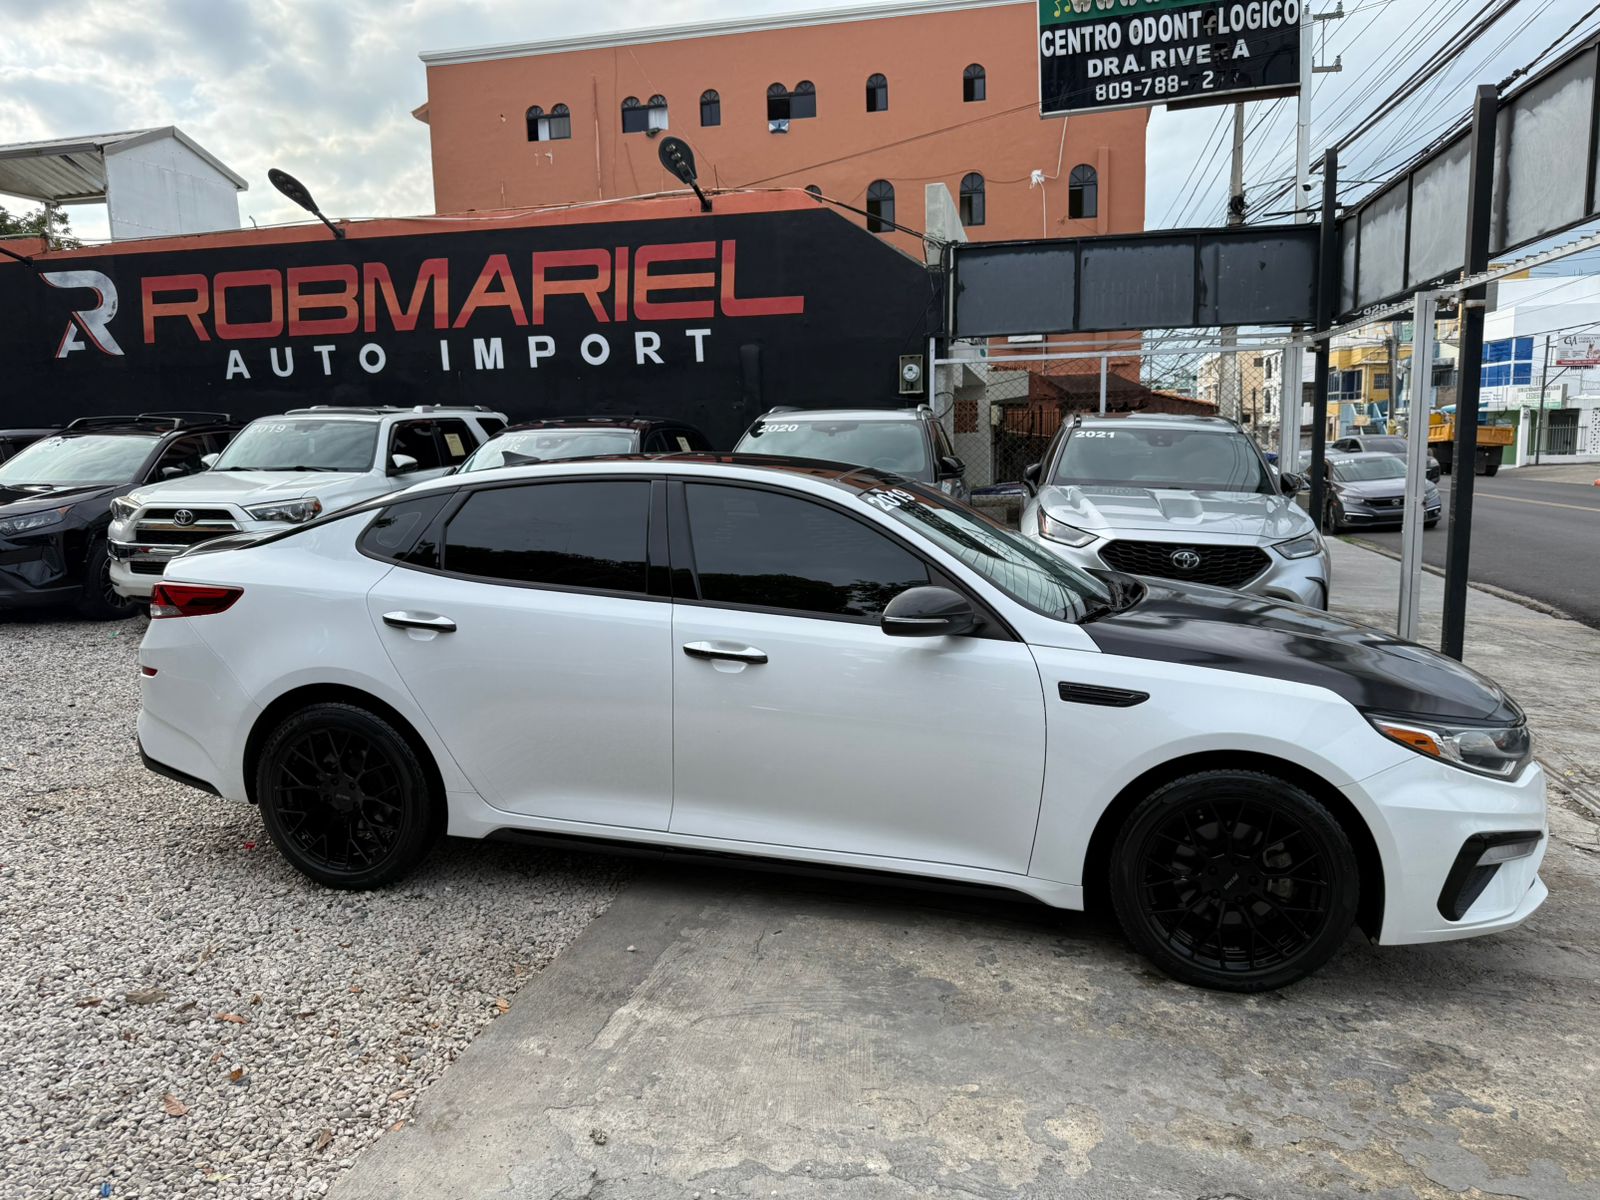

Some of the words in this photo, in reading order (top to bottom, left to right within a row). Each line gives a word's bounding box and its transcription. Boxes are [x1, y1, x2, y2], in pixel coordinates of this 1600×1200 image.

[1040, 22, 1121, 57] CENTRO
[1087, 54, 1146, 78] DRA.
[141, 239, 805, 344] ROBMARIEL
[225, 342, 387, 380] AUTO
[439, 328, 712, 371] IMPORT
[756, 424, 799, 433] 2020
[1074, 430, 1116, 439] 2021
[867, 488, 916, 512] 2019
